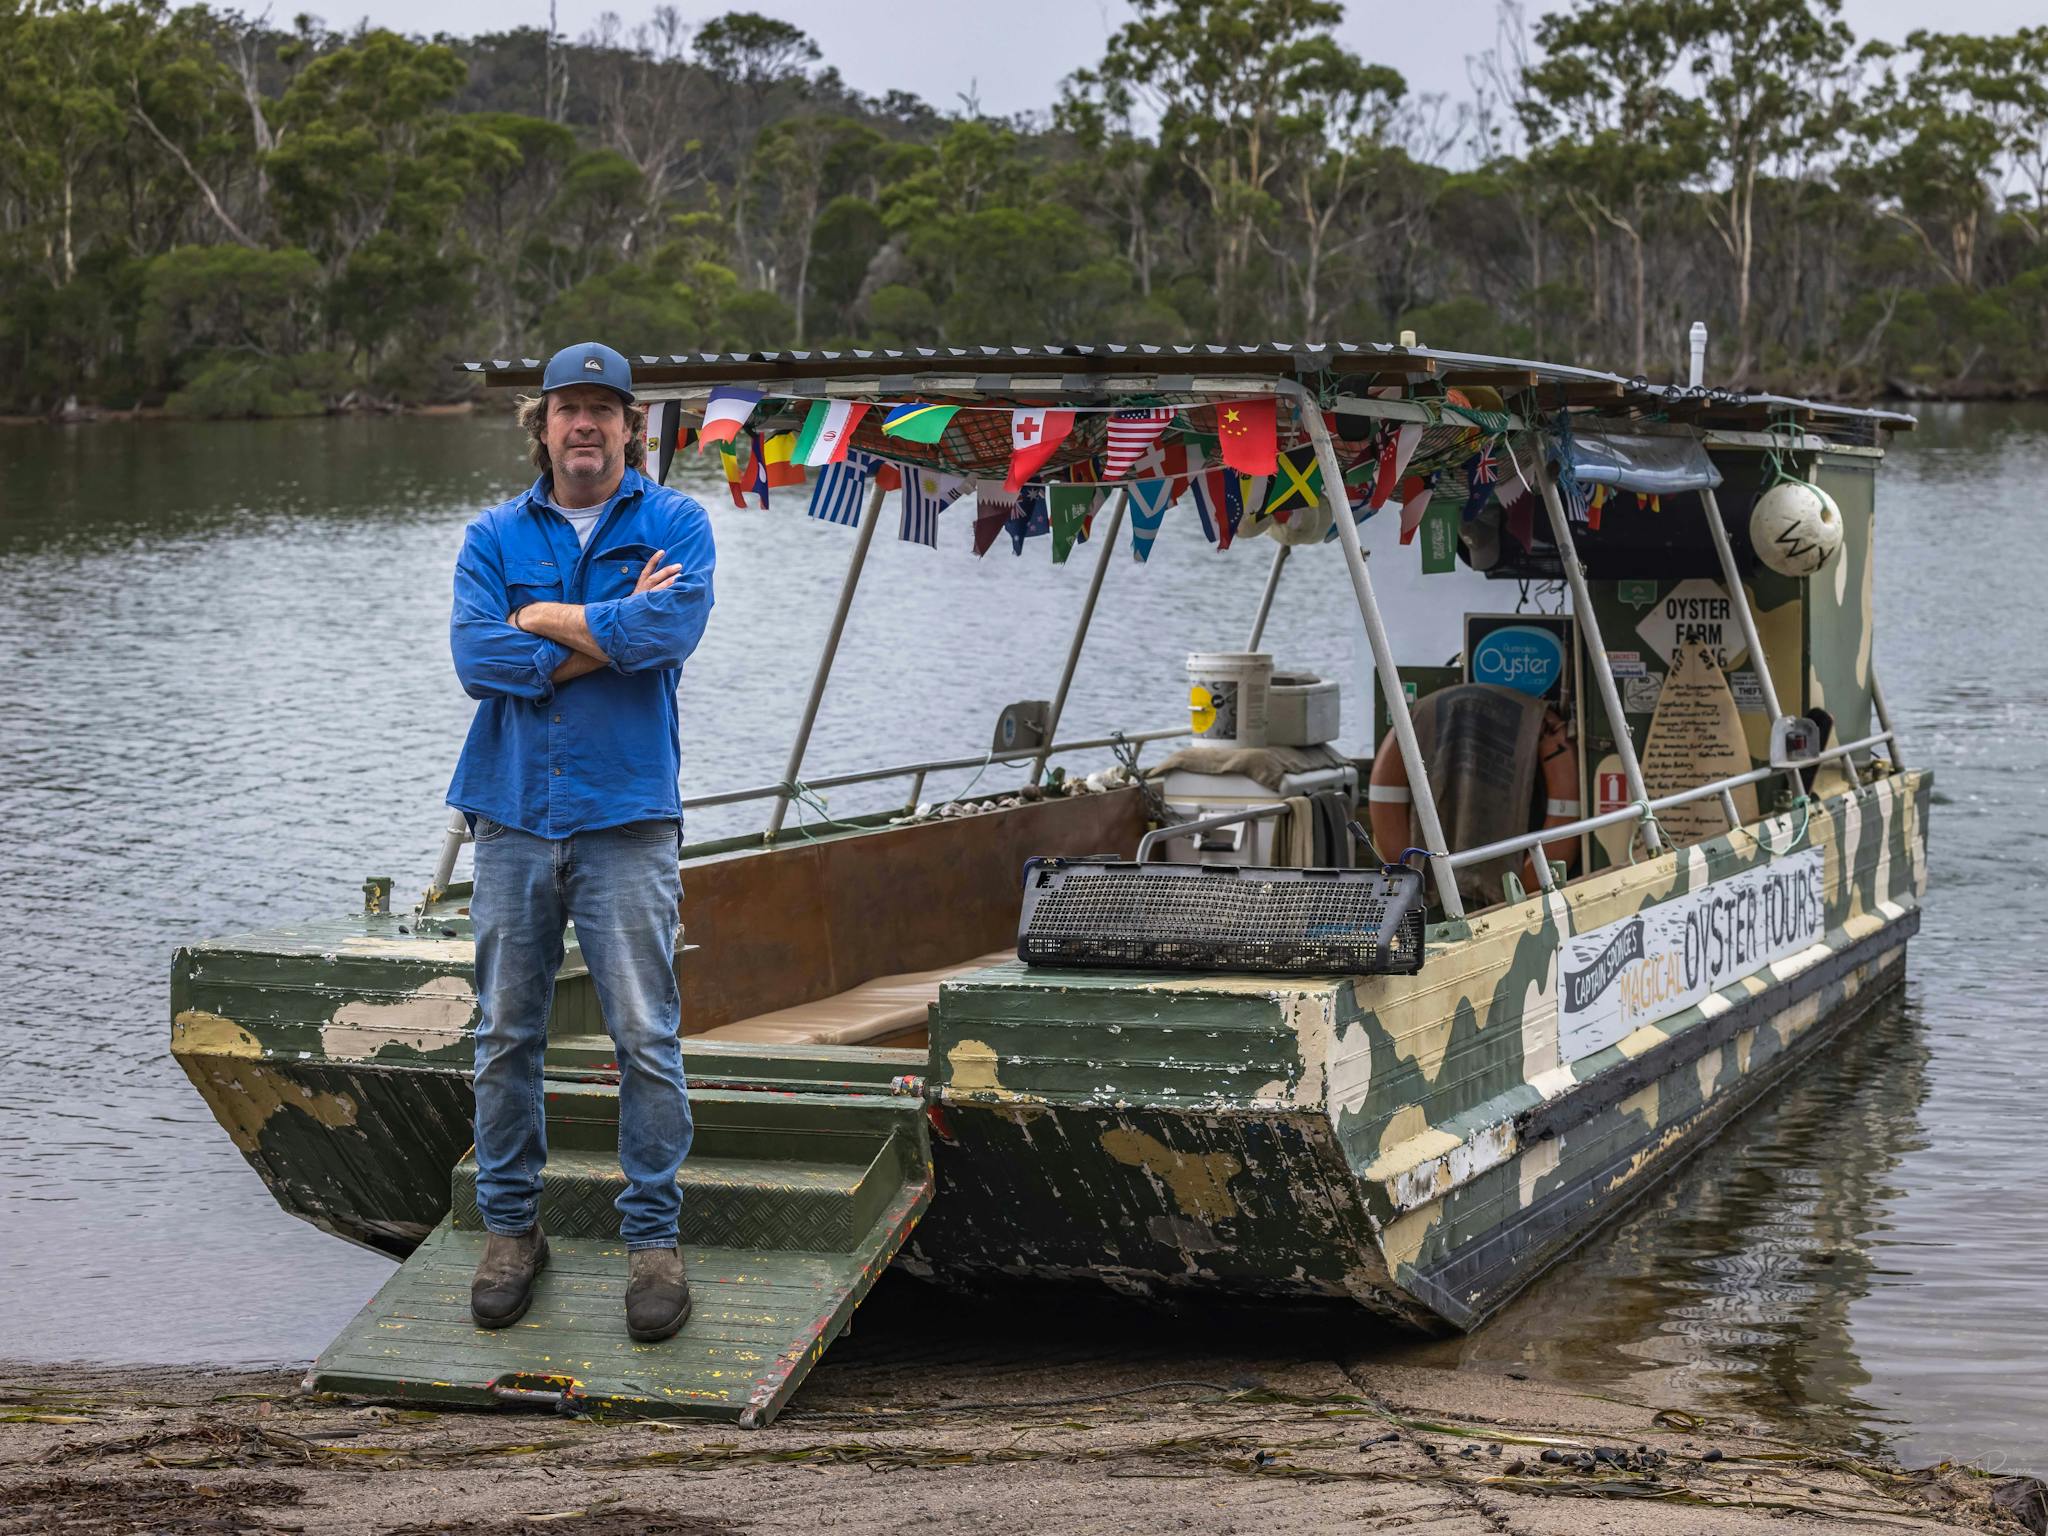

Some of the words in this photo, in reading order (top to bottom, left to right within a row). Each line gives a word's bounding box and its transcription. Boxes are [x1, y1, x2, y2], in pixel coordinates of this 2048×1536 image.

[1666, 598, 1730, 620] OYSTER
[1676, 623, 1722, 644] FARM
[1480, 647, 1551, 681] Oyster
[1620, 950, 1684, 1023] MAGICAL
[1685, 886, 1757, 992] OYSTER
[1762, 864, 1818, 955] TOURS
[1574, 959, 1606, 1006] CAPTAIN
